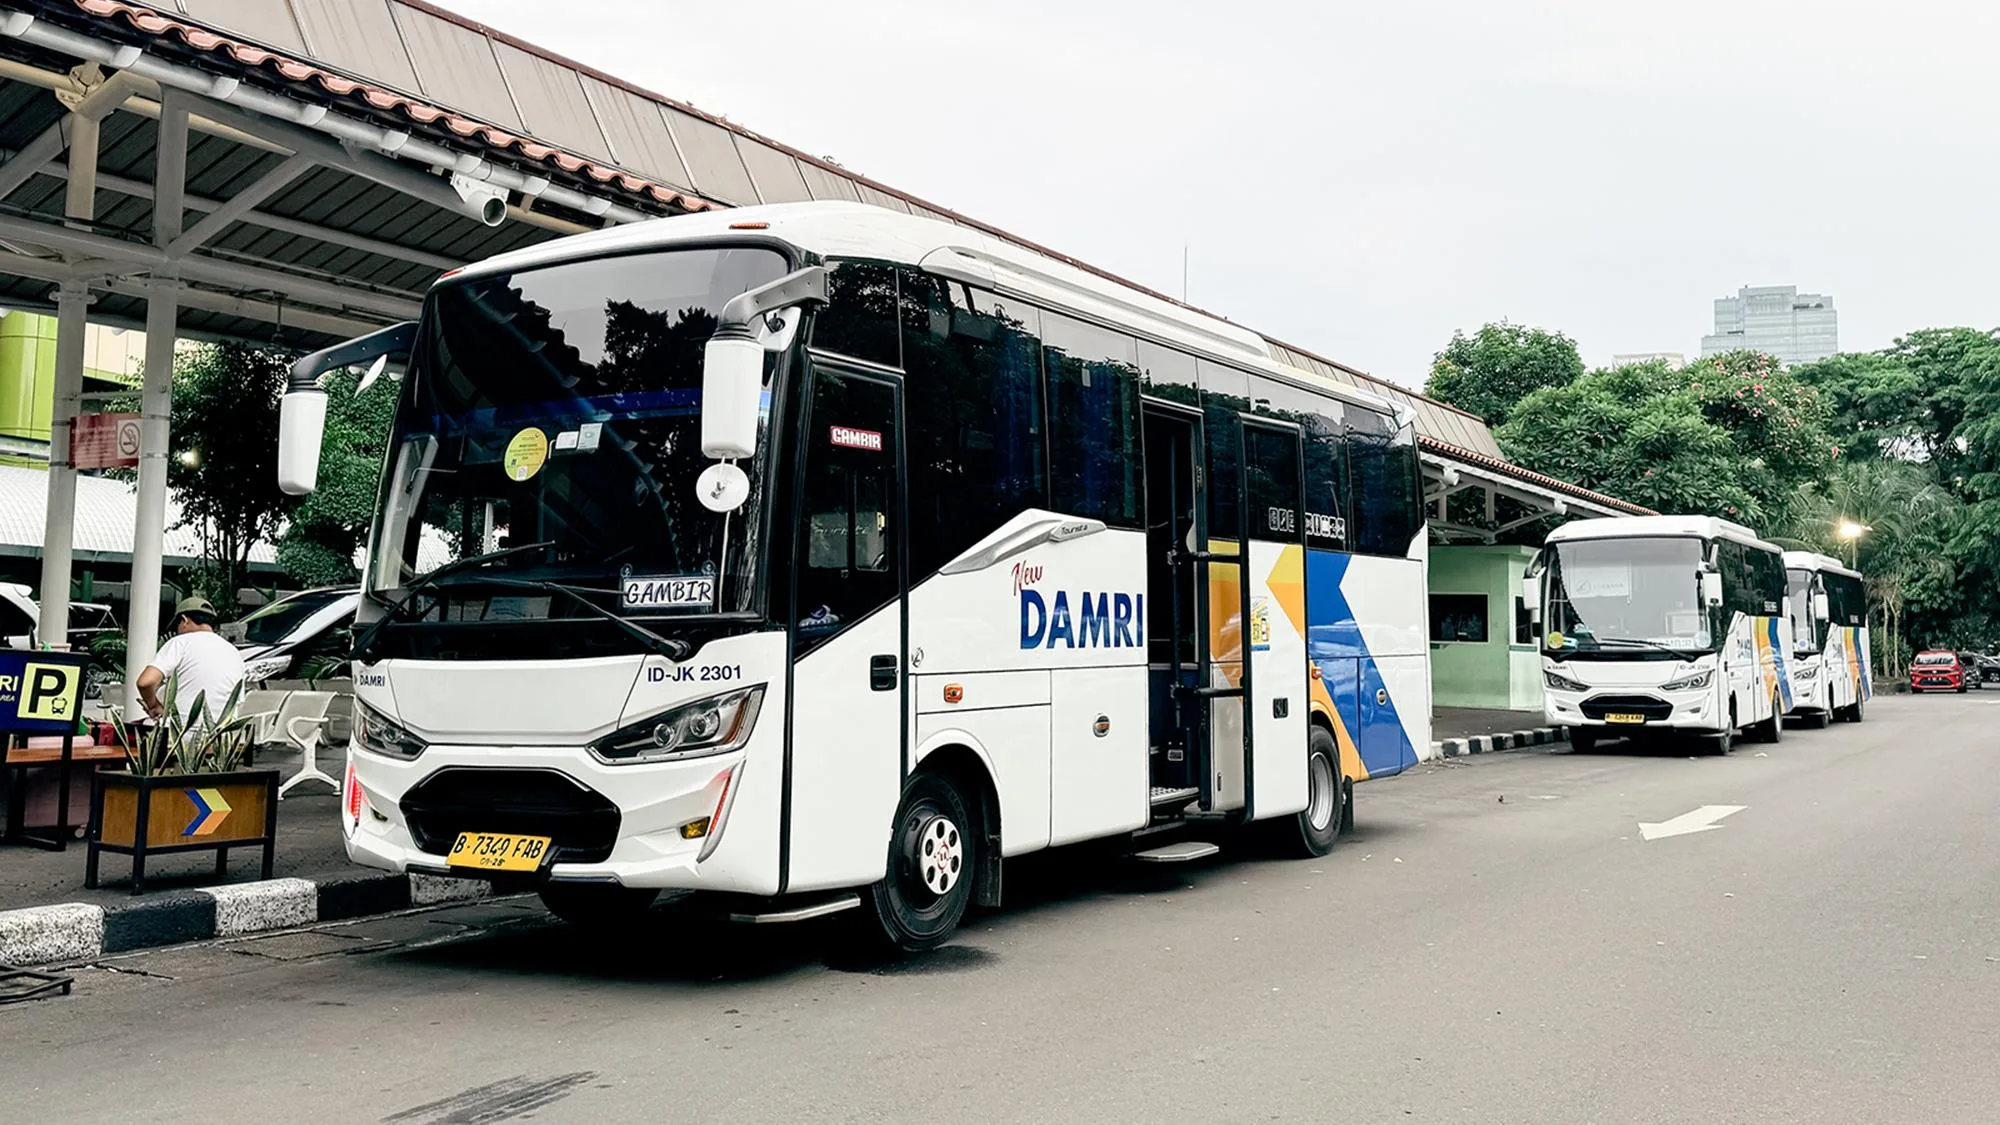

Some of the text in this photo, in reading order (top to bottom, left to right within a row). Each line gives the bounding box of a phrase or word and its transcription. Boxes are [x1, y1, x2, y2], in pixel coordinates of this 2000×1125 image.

[832, 427, 881, 448] GAMBIR
[1011, 560, 1043, 596] New
[626, 580, 712, 605] GAMBIR
[1020, 589, 1144, 649] DAMRI
[359, 674, 386, 687] DAMRI
[647, 665, 741, 682] ID-JK 2301
[28, 667, 67, 713] P
[453, 835, 544, 859] B 7349 FAB
